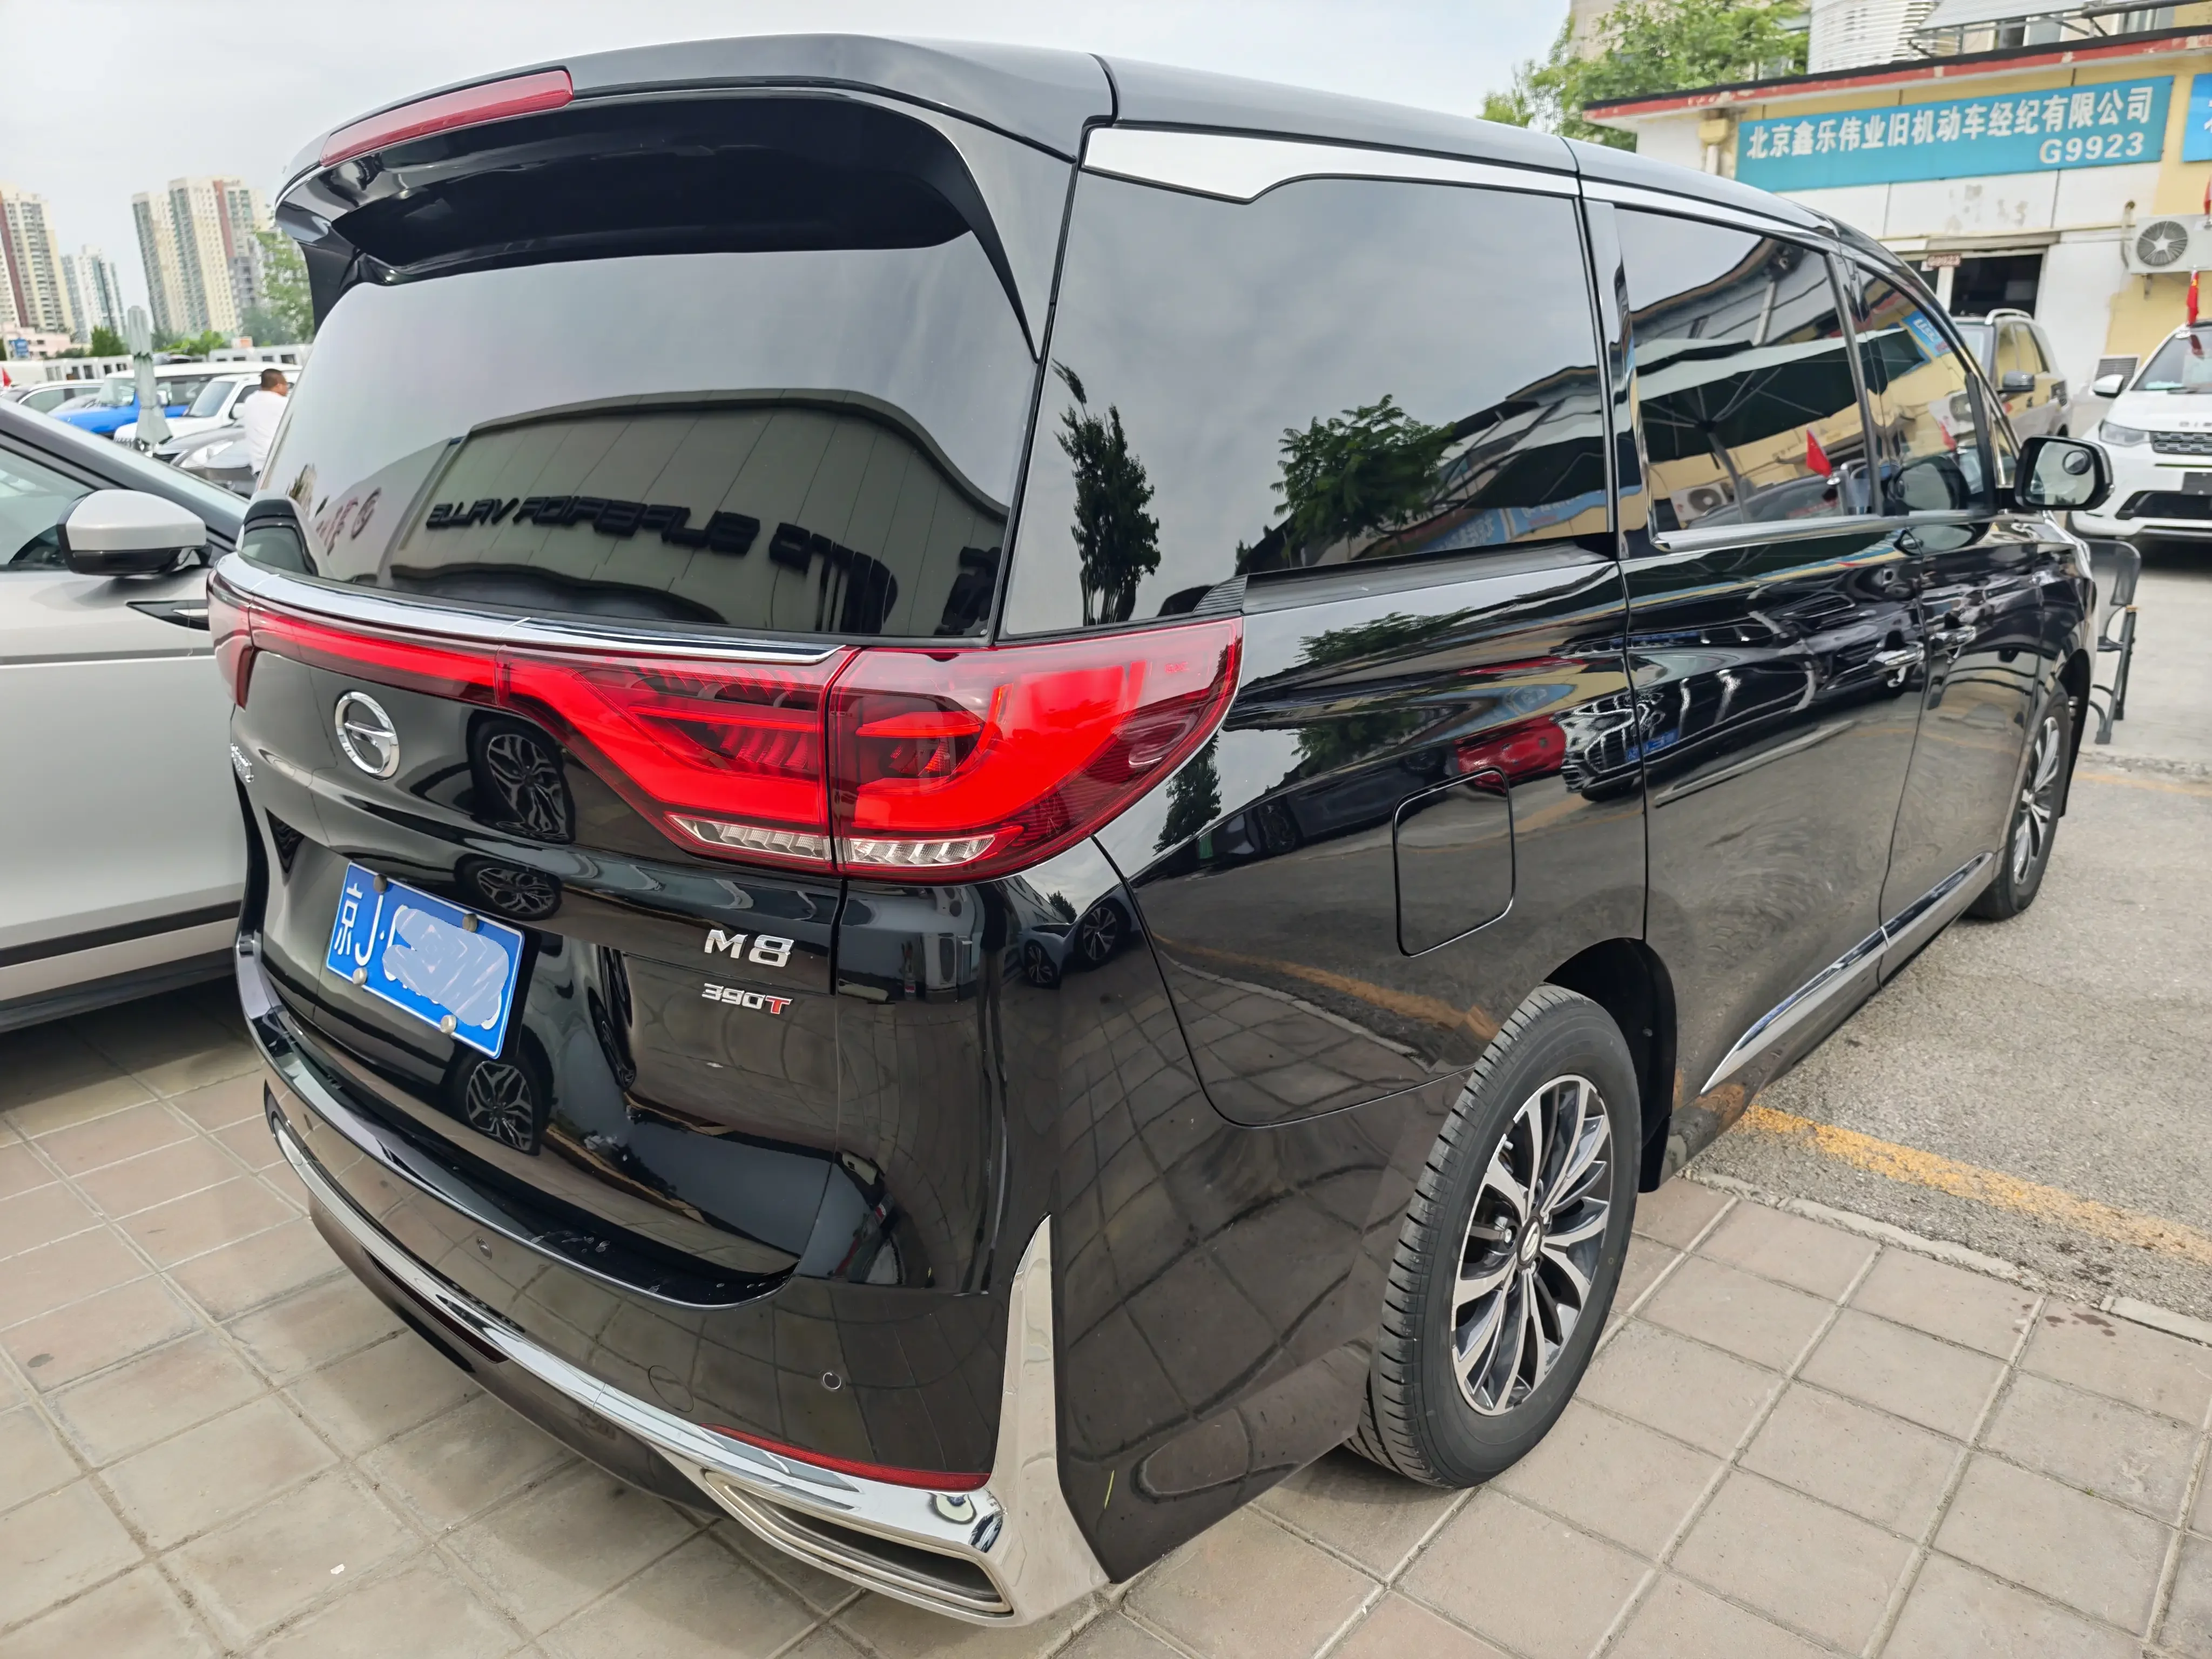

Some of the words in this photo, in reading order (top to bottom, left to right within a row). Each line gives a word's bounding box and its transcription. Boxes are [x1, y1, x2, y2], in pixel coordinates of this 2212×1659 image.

[1746, 86, 2154, 159] 北京鑫乐伟业旧机动车经纪有限公司
[2039, 132, 2144, 164] G9923
[704, 929, 794, 967] M8
[702, 983, 793, 1015] 390T
